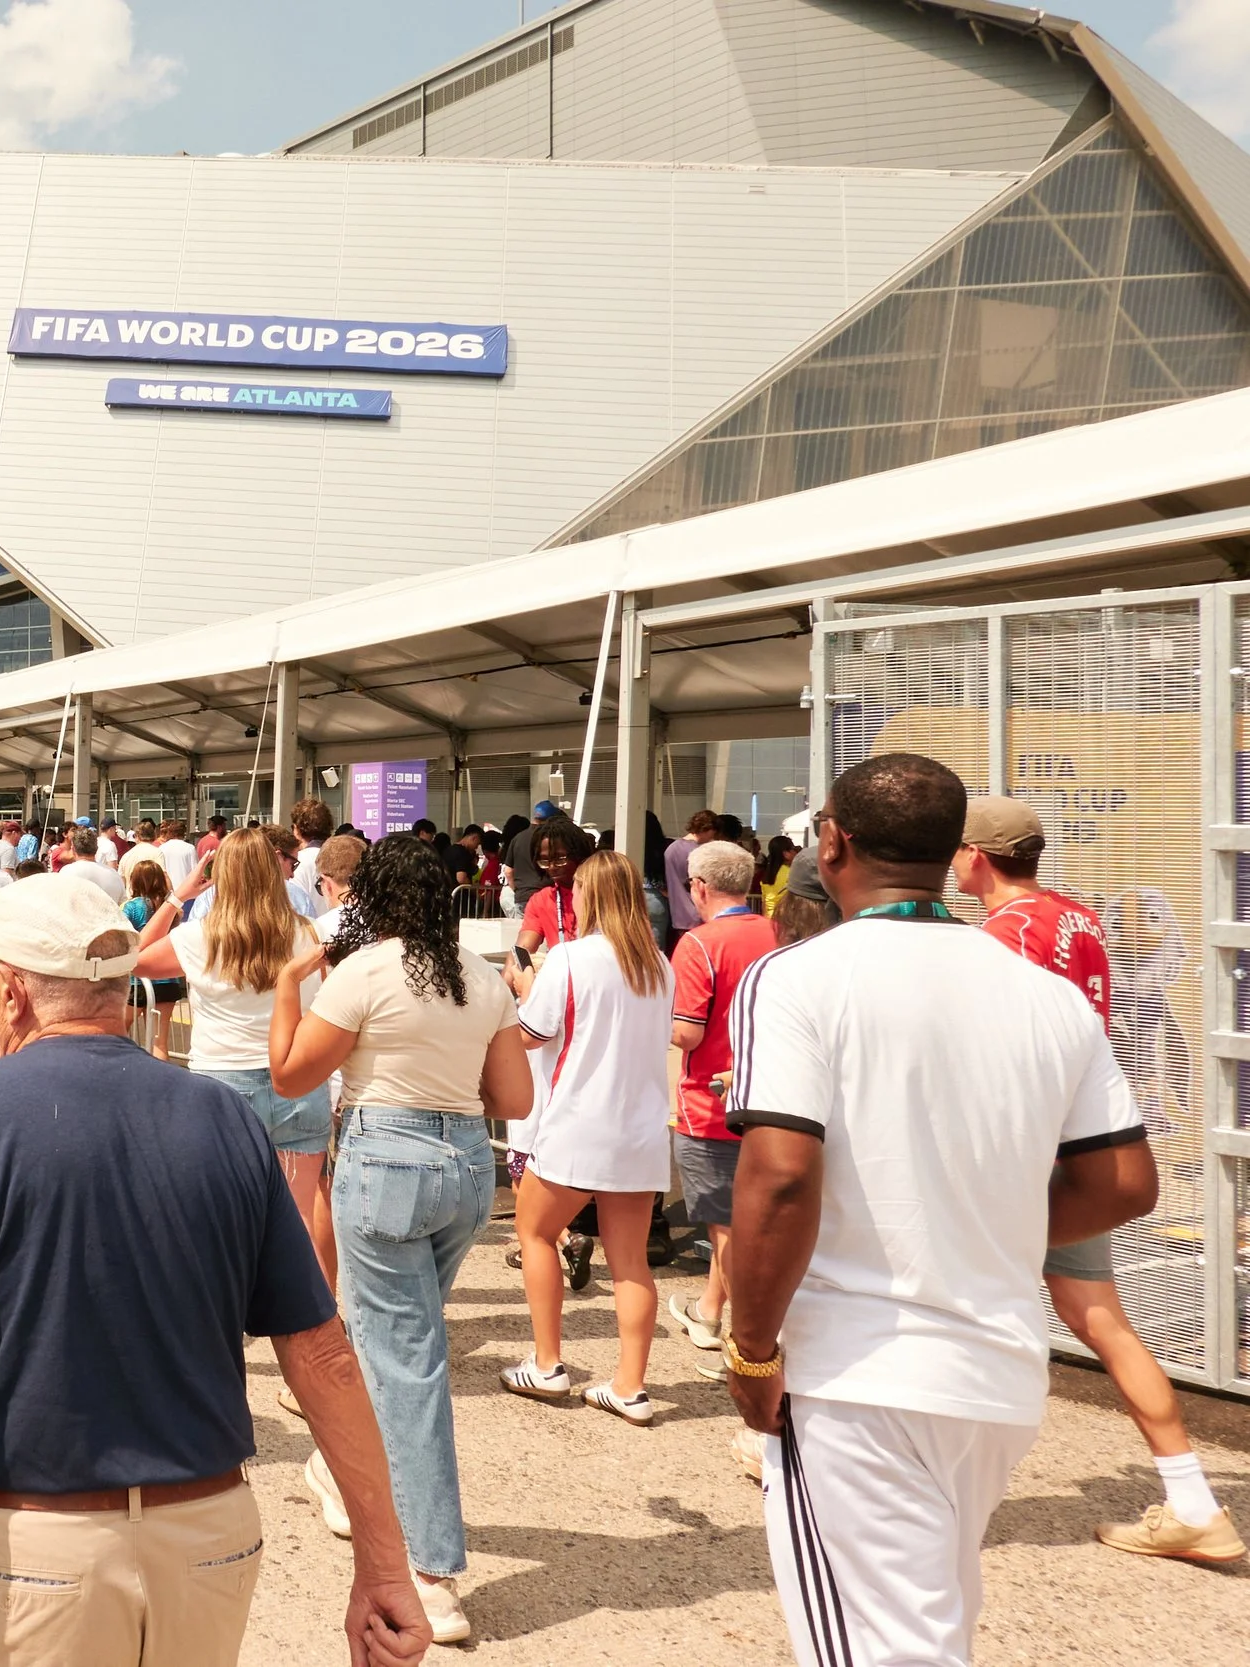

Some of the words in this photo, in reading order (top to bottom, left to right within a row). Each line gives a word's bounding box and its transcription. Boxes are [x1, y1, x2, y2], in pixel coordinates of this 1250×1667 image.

[30, 316, 110, 343] FIFA
[117, 319, 254, 349] WORLD
[261, 325, 339, 352] CUP
[344, 329, 485, 359] 2026
[234, 388, 358, 408] ATLANTA
